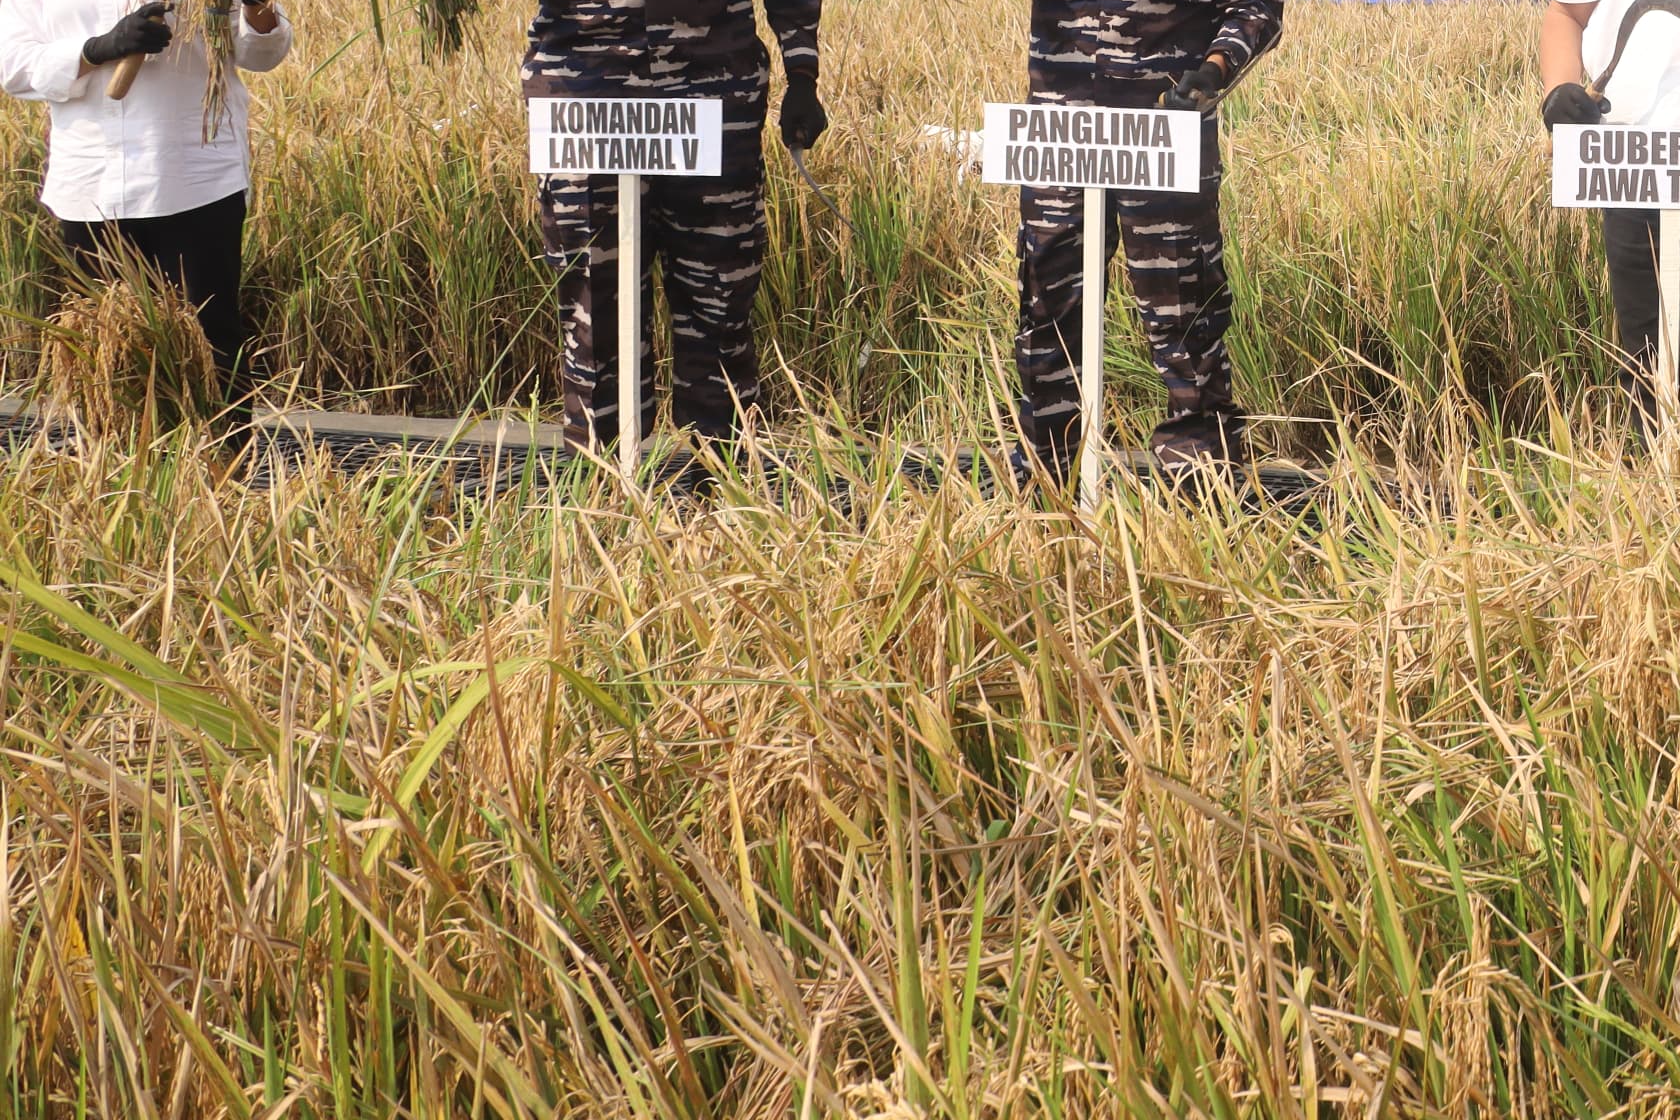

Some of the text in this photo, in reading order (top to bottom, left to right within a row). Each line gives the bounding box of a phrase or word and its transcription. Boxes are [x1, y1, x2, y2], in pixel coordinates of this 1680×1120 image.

[550, 102, 697, 135] KOMANDAN
[1009, 109, 1172, 148] PANGLIMA
[549, 137, 699, 170] LANTAMAL V
[1005, 144, 1176, 188] KOARMADA II
[1575, 167, 1660, 203] JAWA
